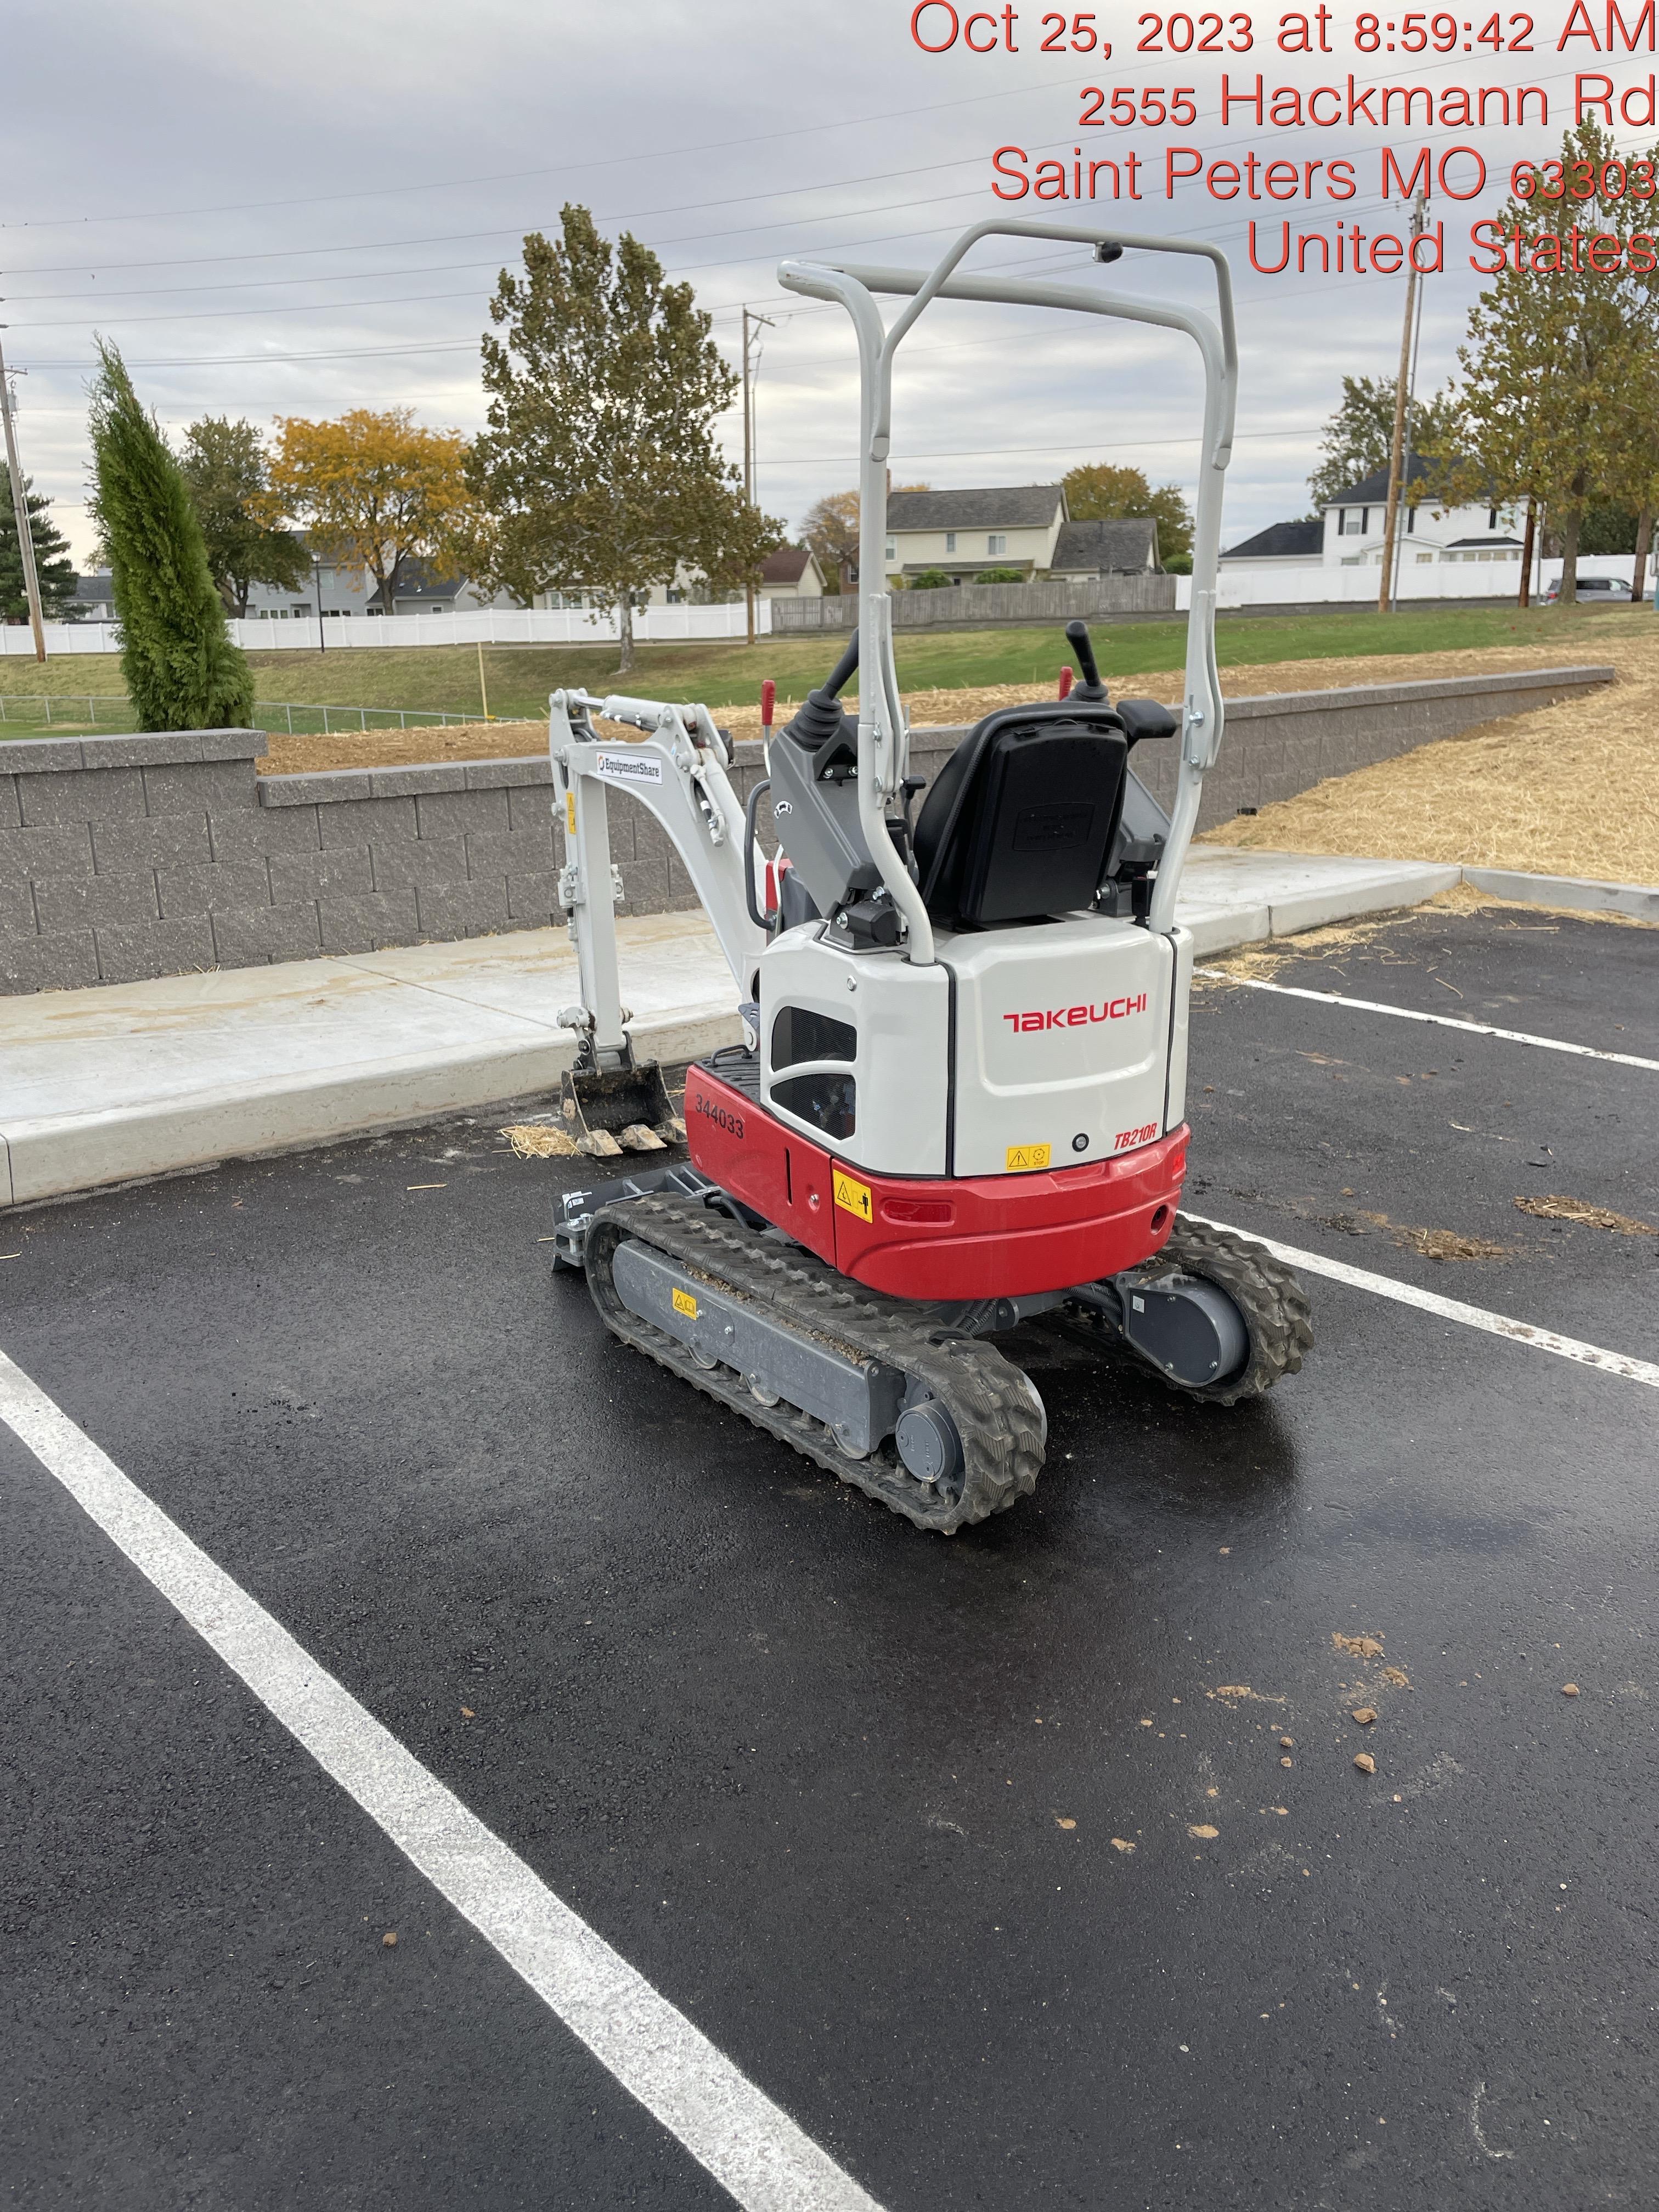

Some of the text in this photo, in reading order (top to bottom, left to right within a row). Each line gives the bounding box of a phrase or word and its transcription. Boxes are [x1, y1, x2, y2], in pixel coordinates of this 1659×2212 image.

[605, 758, 659, 777] EquipmentShare
[695, 1094, 743, 1139] 344033
[1114, 1123, 1158, 1150] TB210R
